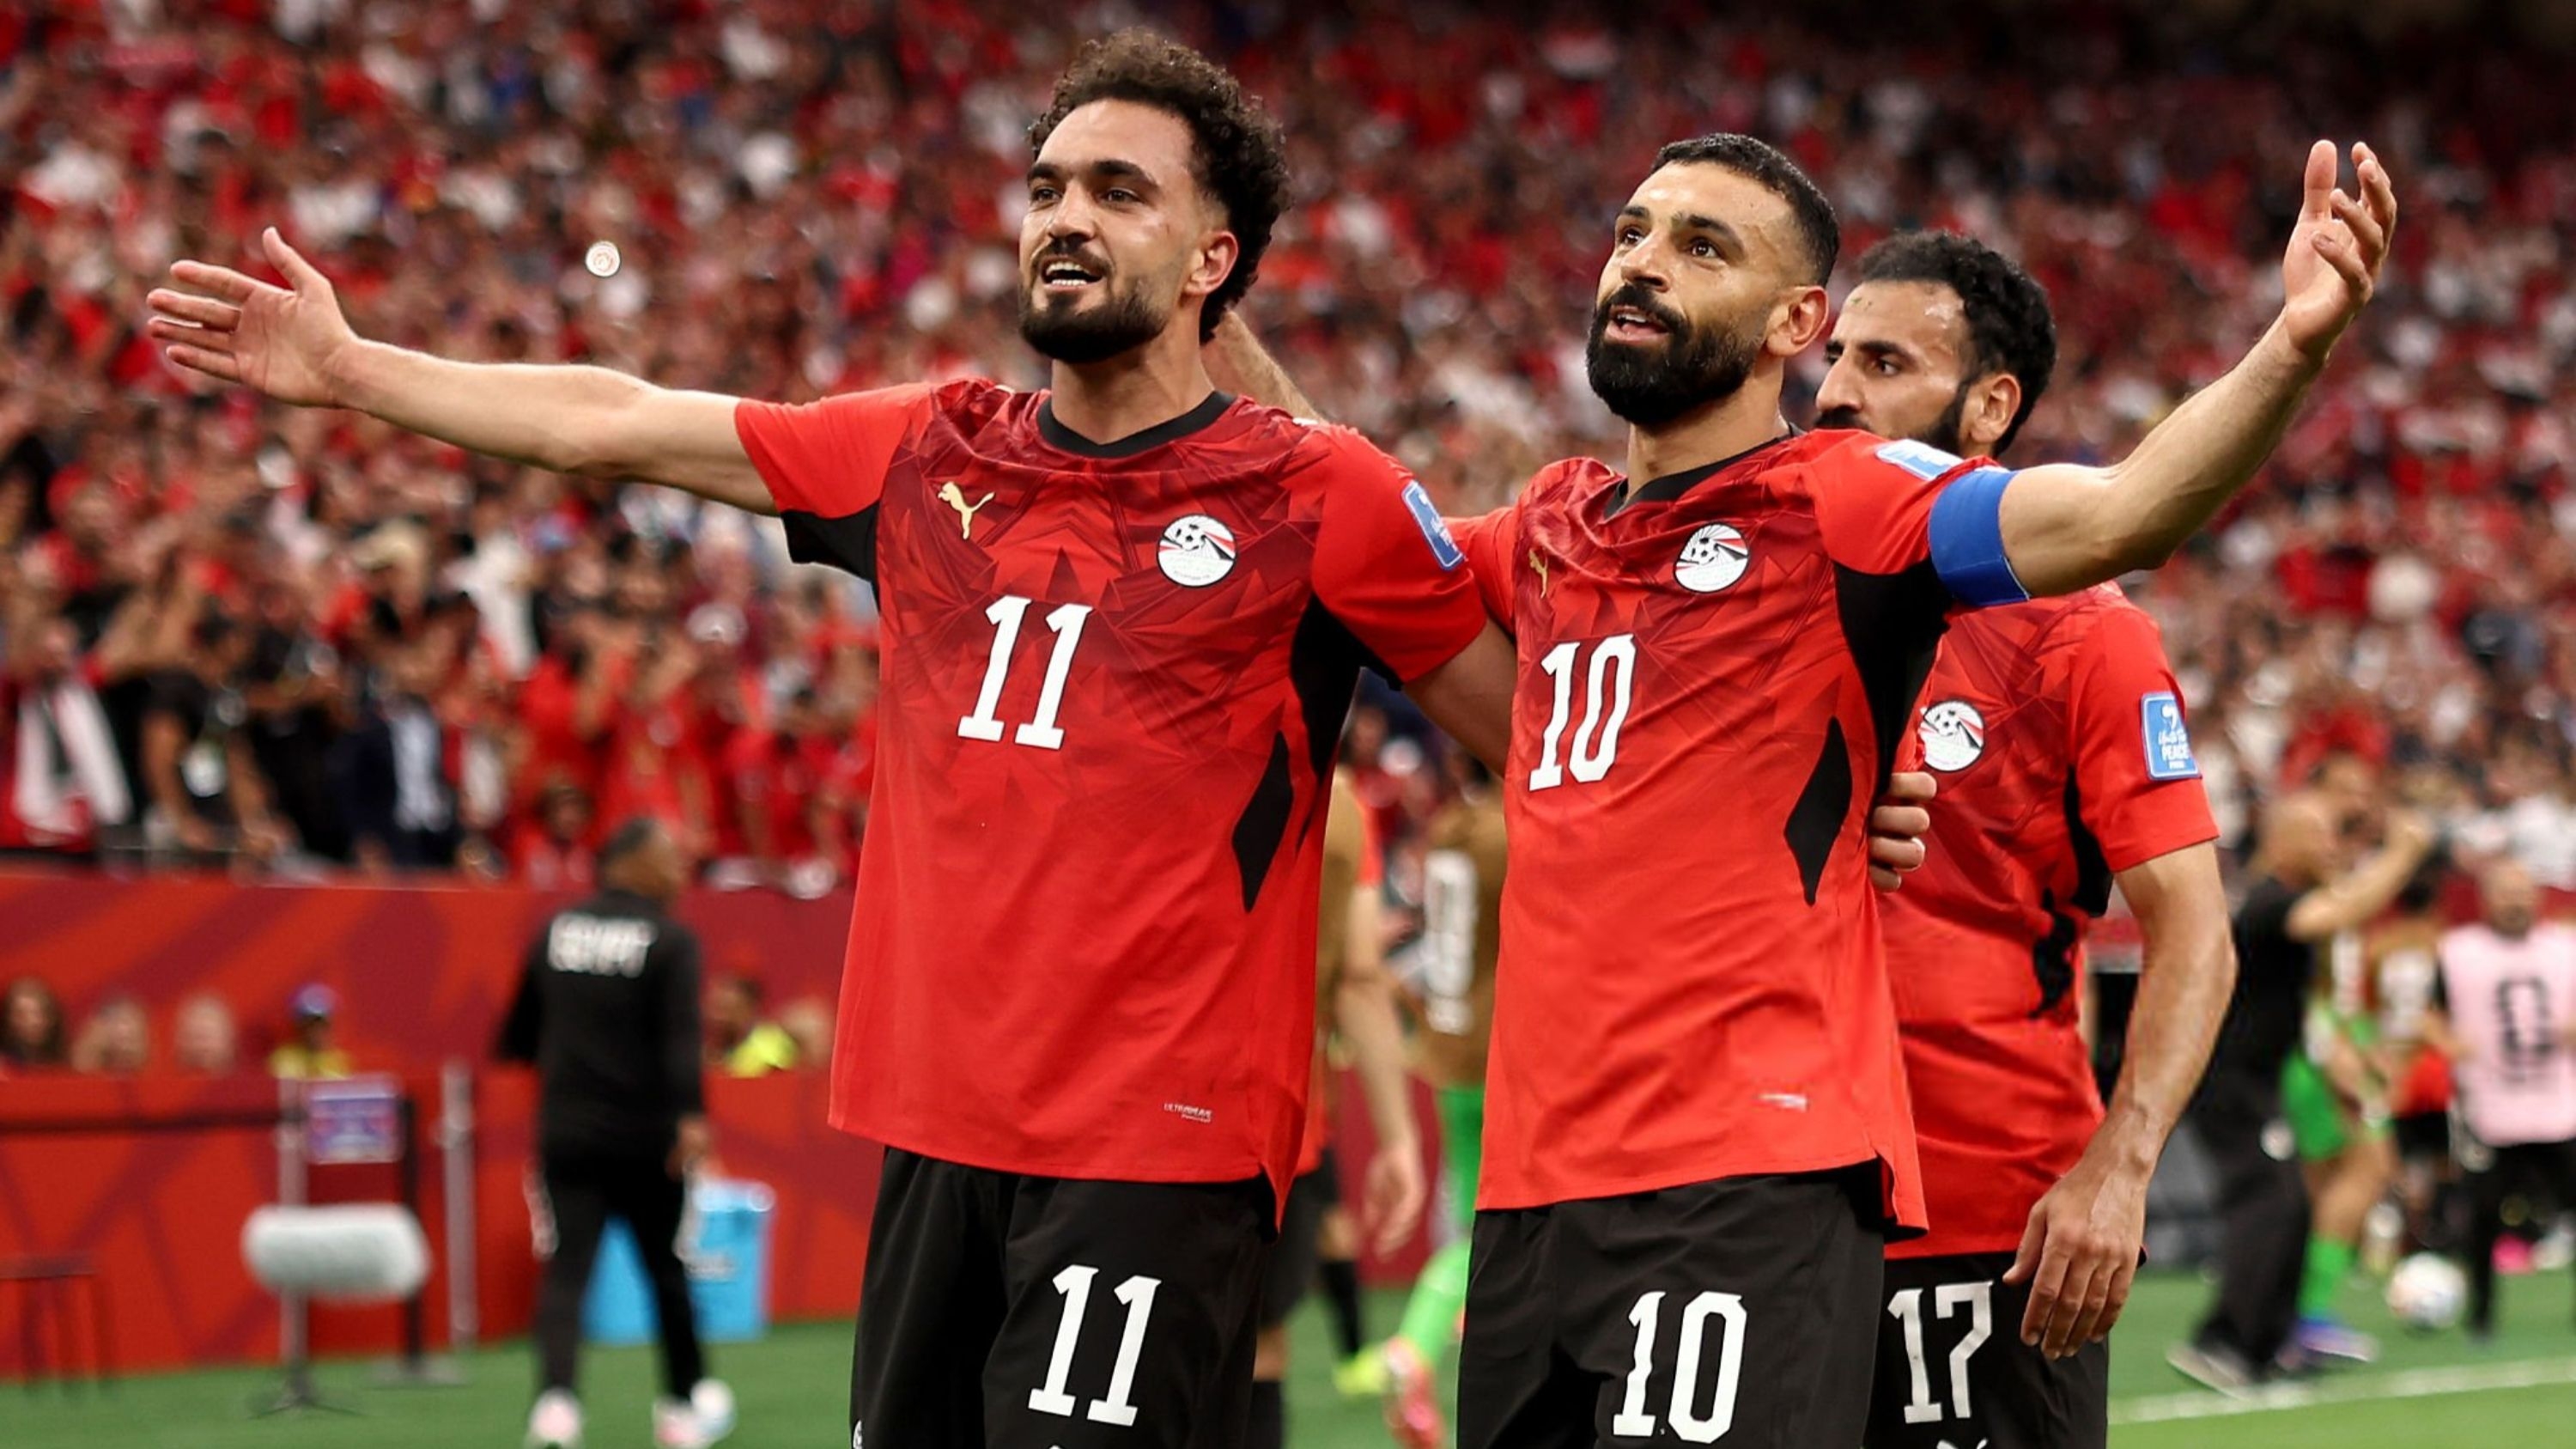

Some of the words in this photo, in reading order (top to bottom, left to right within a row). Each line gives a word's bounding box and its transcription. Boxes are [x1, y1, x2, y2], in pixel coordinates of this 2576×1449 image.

[957, 594, 1093, 750] 11
[1528, 633, 1637, 791] 10
[1028, 1264, 1162, 1426] 11
[1613, 1291, 1747, 1444] 10
[1887, 1280, 1993, 1424] 17
